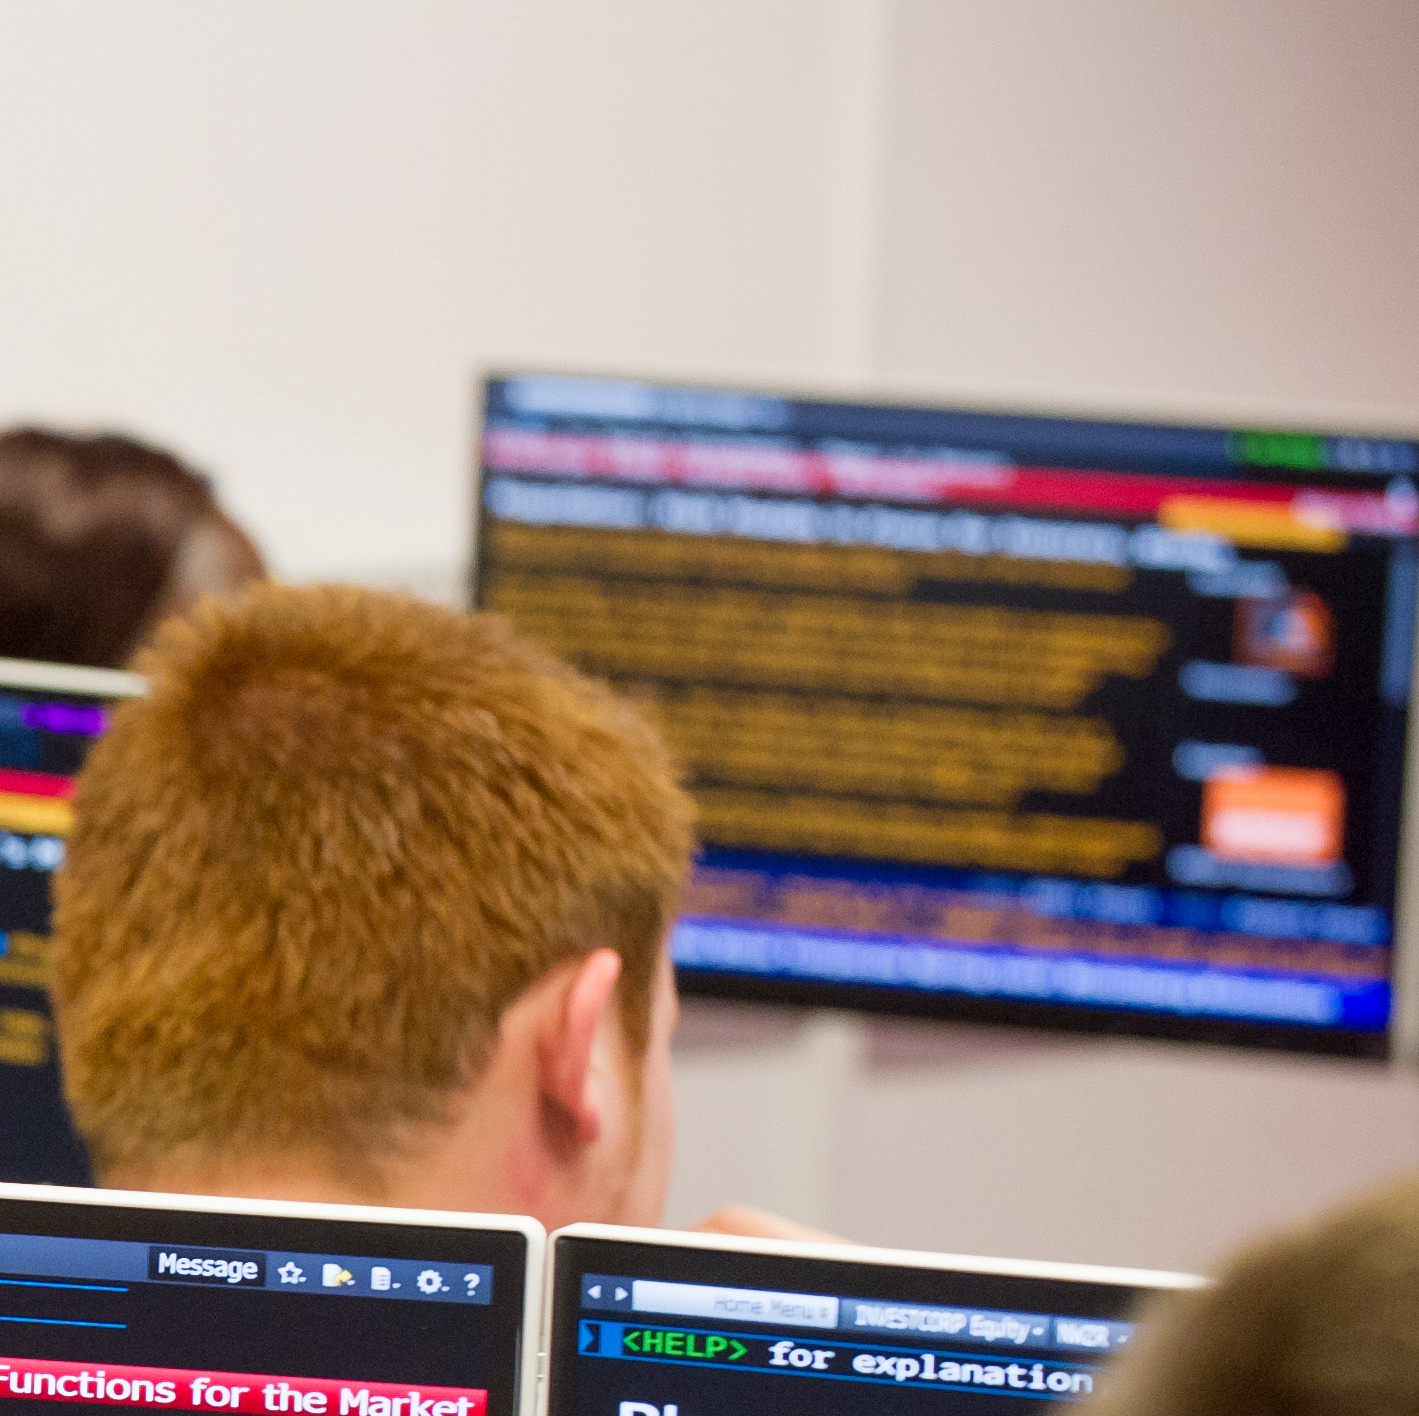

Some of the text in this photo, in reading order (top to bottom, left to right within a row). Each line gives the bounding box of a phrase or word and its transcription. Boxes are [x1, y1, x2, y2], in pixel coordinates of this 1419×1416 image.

[157, 1252, 259, 1284] Message
[624, 1330, 1094, 1394] <HELP> for explanation
[189, 1377, 250, 1408] for
[262, 1382, 328, 1414] the
